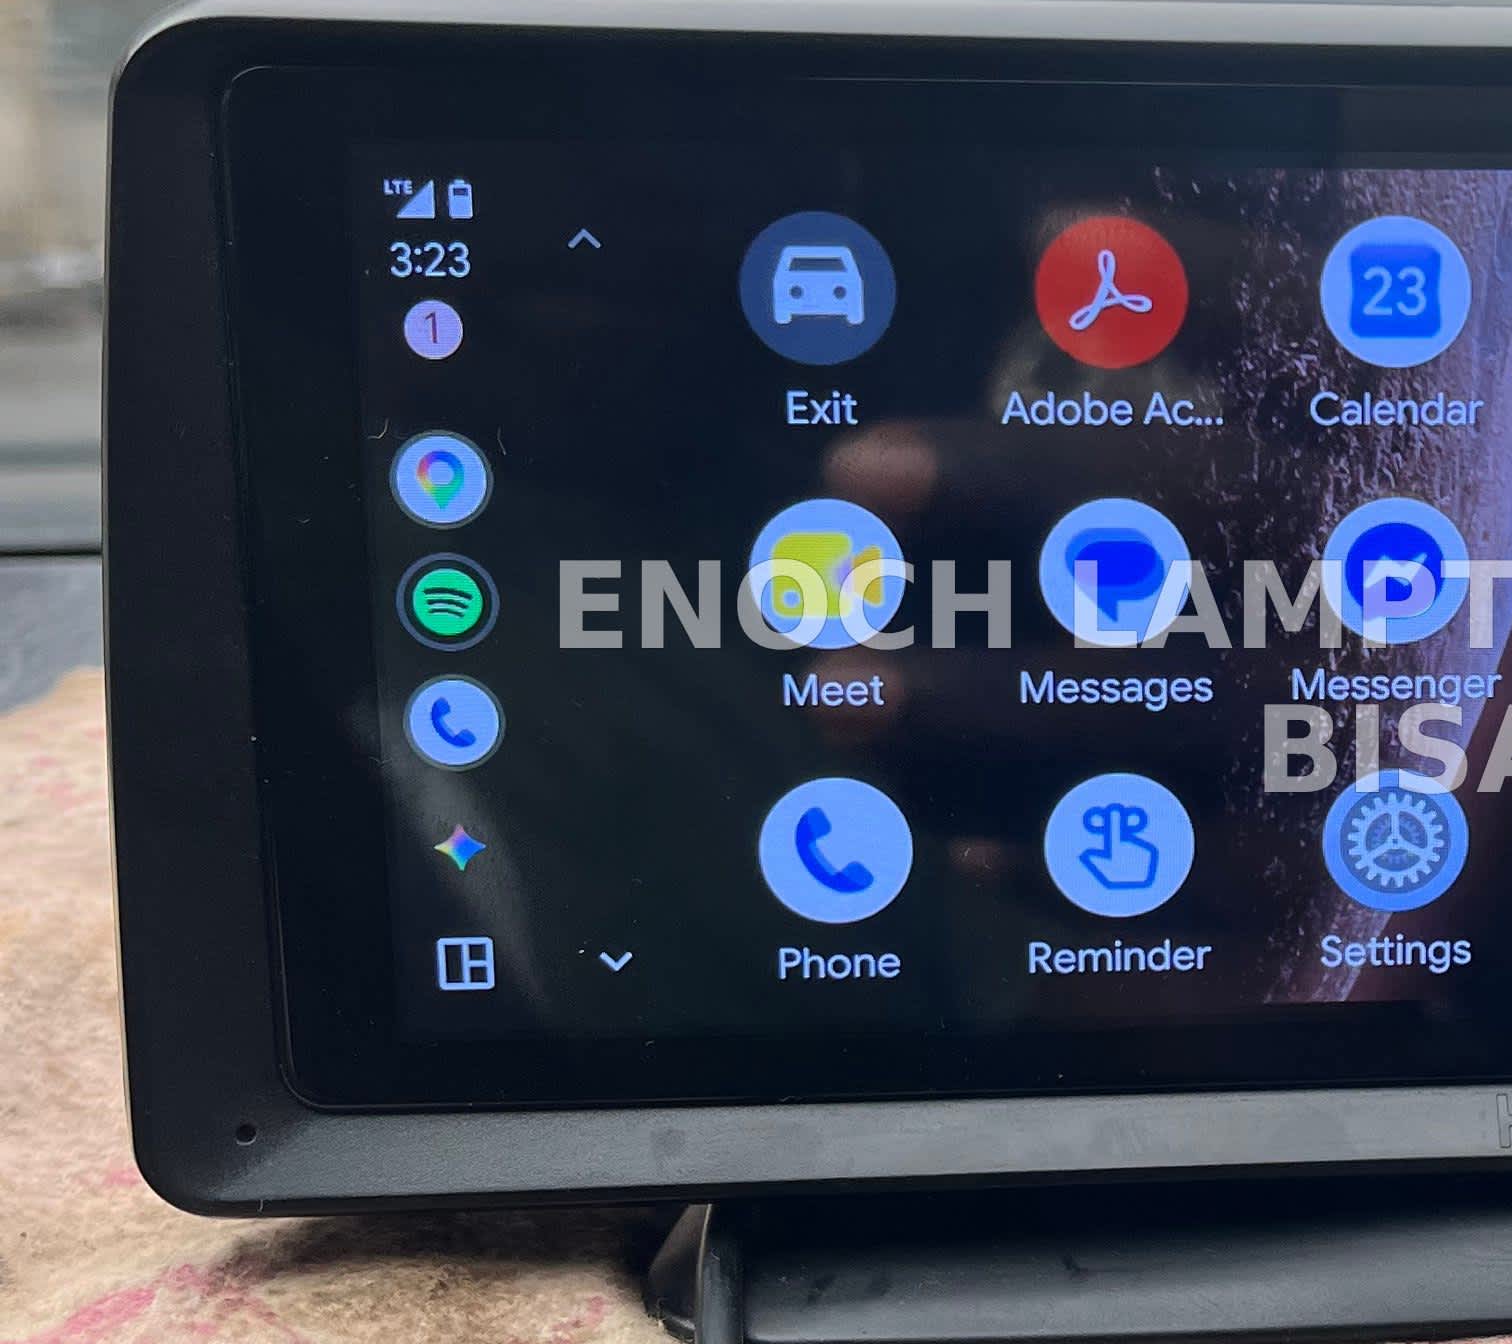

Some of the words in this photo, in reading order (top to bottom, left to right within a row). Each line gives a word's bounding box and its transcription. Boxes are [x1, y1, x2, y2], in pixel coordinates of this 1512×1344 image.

[383, 178, 413, 196] LTE
[388, 241, 472, 279] 3:23
[1361, 265, 1429, 317] 23
[424, 311, 440, 344] 1
[785, 390, 859, 425] Exit
[1001, 391, 1133, 426] Adobe
[1143, 392, 1224, 426] Ac...
[1309, 391, 1484, 427] Calendar
[783, 673, 884, 708] Meet
[1019, 670, 1214, 712] Messages
[1291, 667, 1502, 707] Messenger
[778, 947, 901, 981] Phone
[1028, 939, 1212, 975] Reminder
[1320, 934, 1471, 975] Settings
